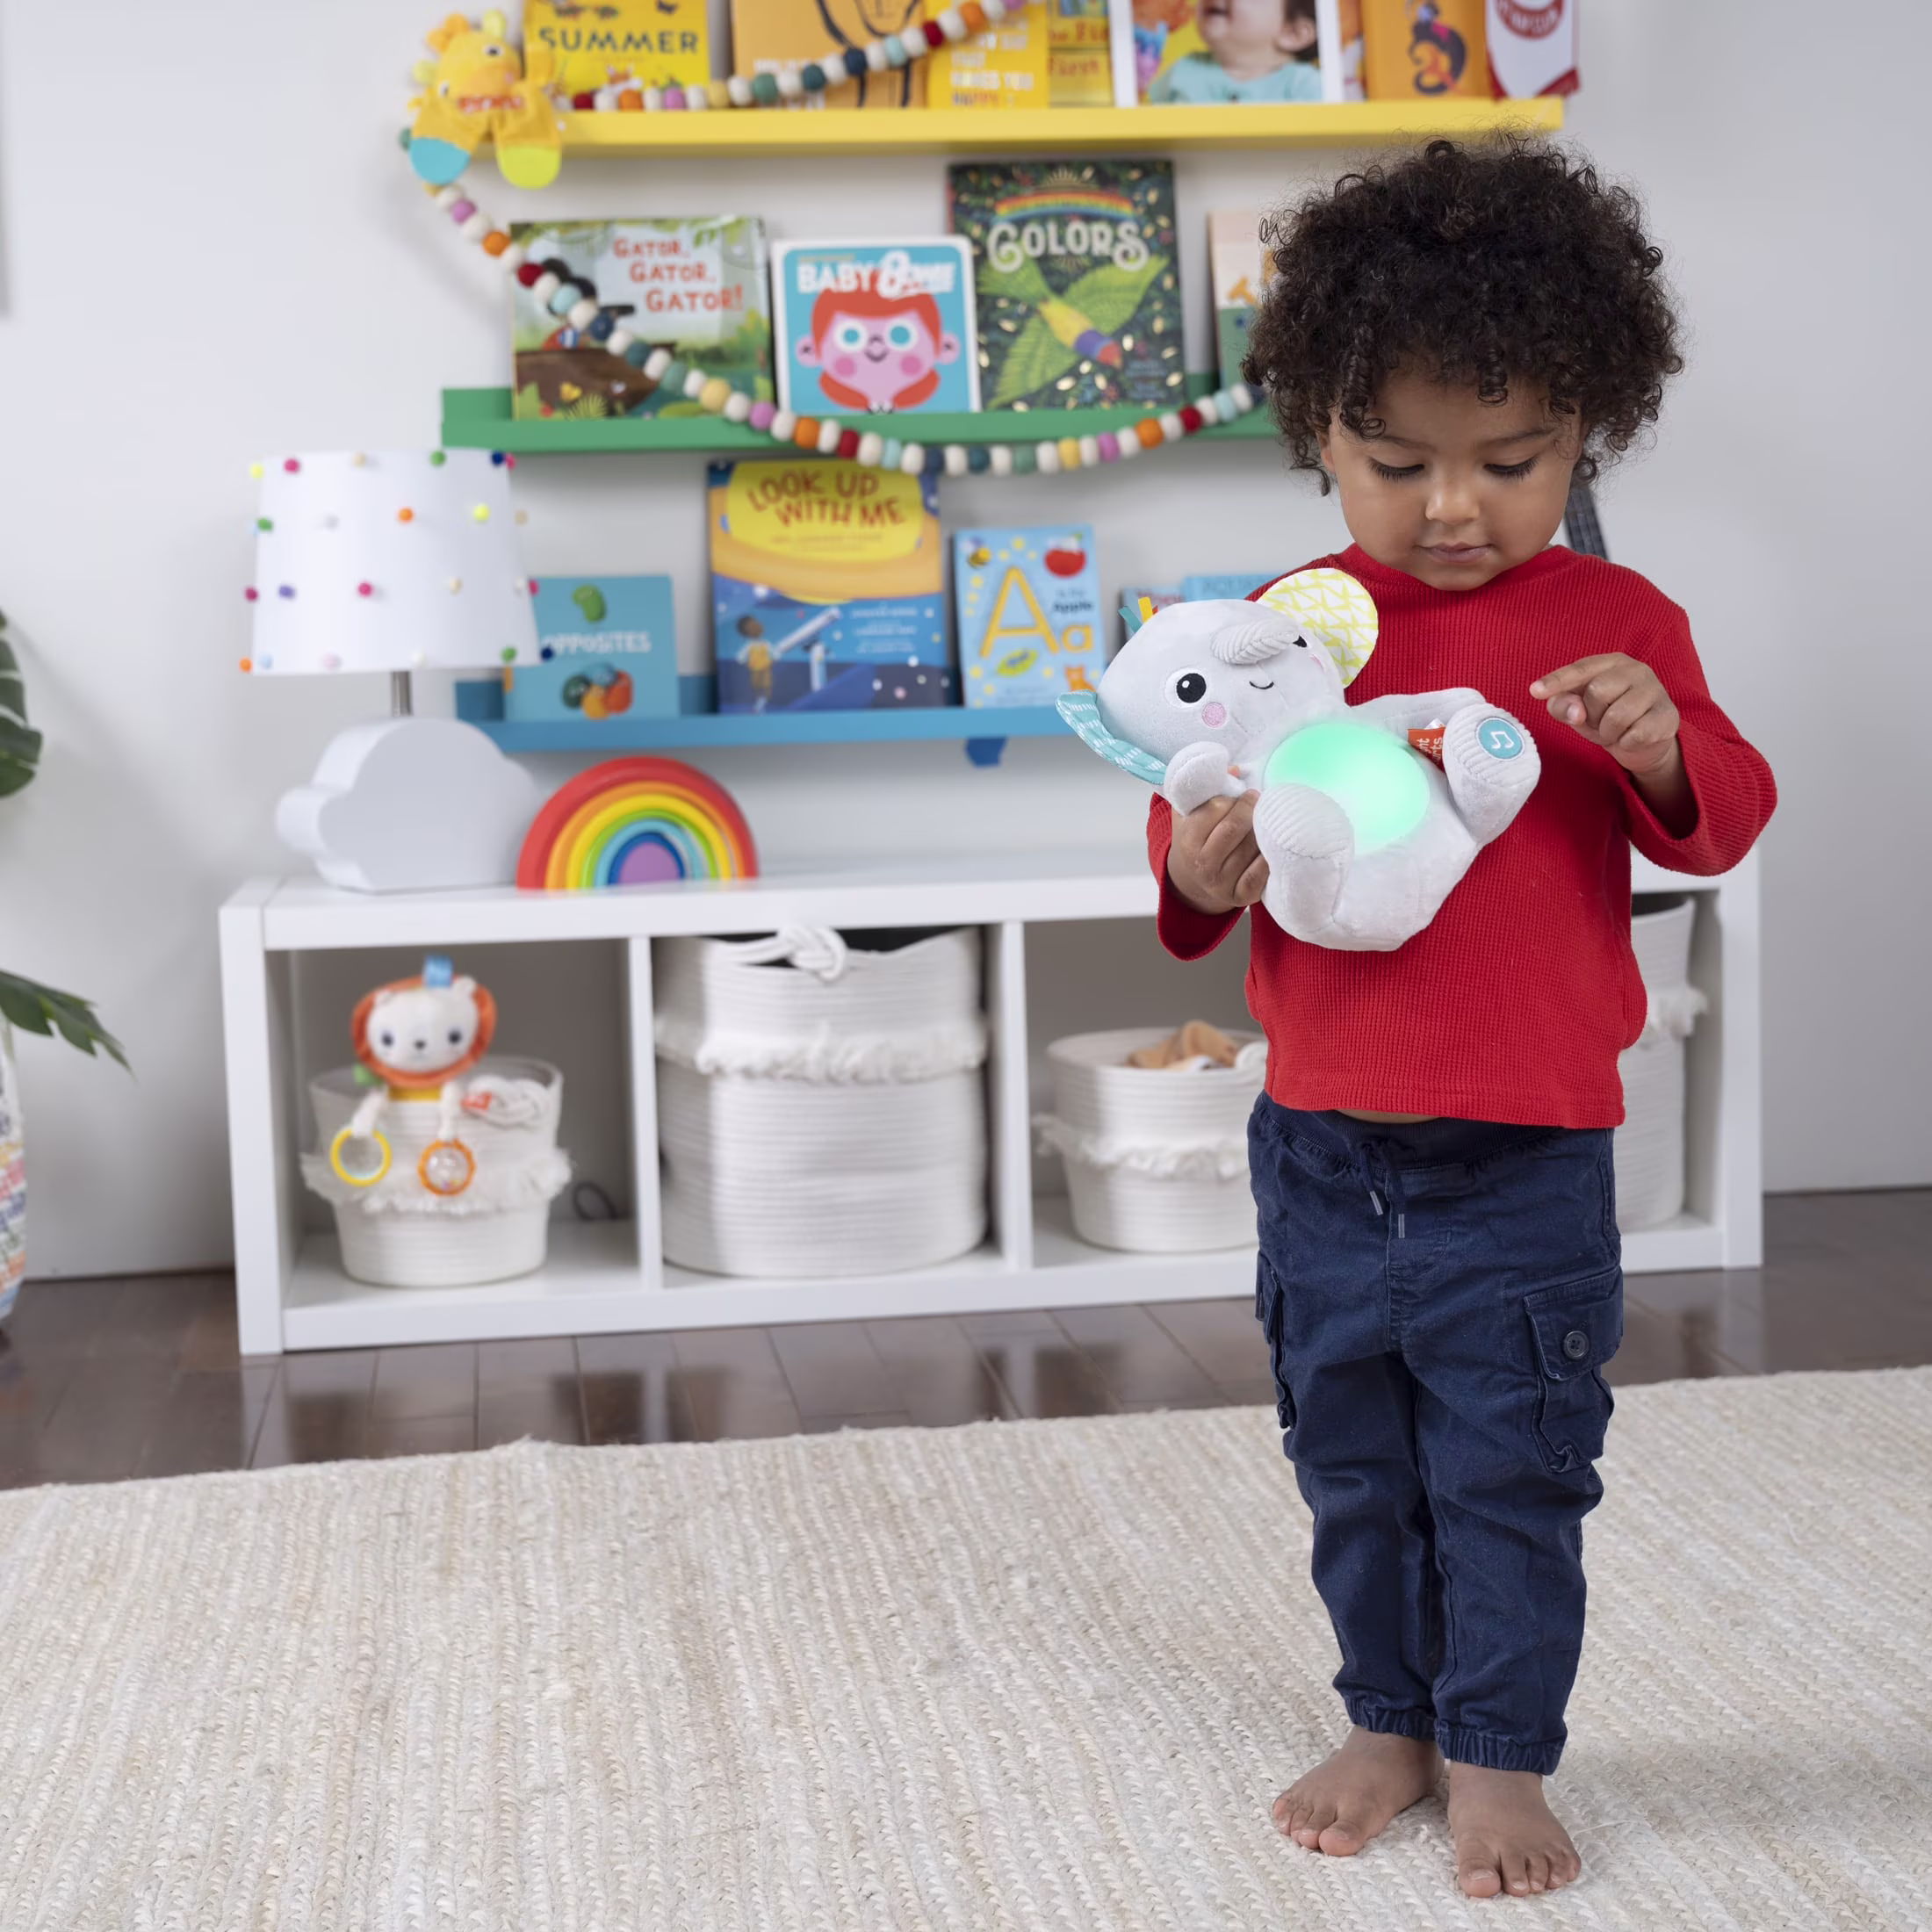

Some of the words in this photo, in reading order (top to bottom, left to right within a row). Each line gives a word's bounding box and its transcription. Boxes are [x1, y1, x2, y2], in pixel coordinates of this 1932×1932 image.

[538, 27, 699, 54] SUMMER
[987, 220, 1150, 273] COLORS
[797, 262, 876, 294] BABY
[645, 284, 744, 313] GATOR!
[747, 469, 825, 513] LOOK
[835, 471, 880, 500] UP
[775, 498, 852, 528] WITH
[861, 494, 908, 528] ME
